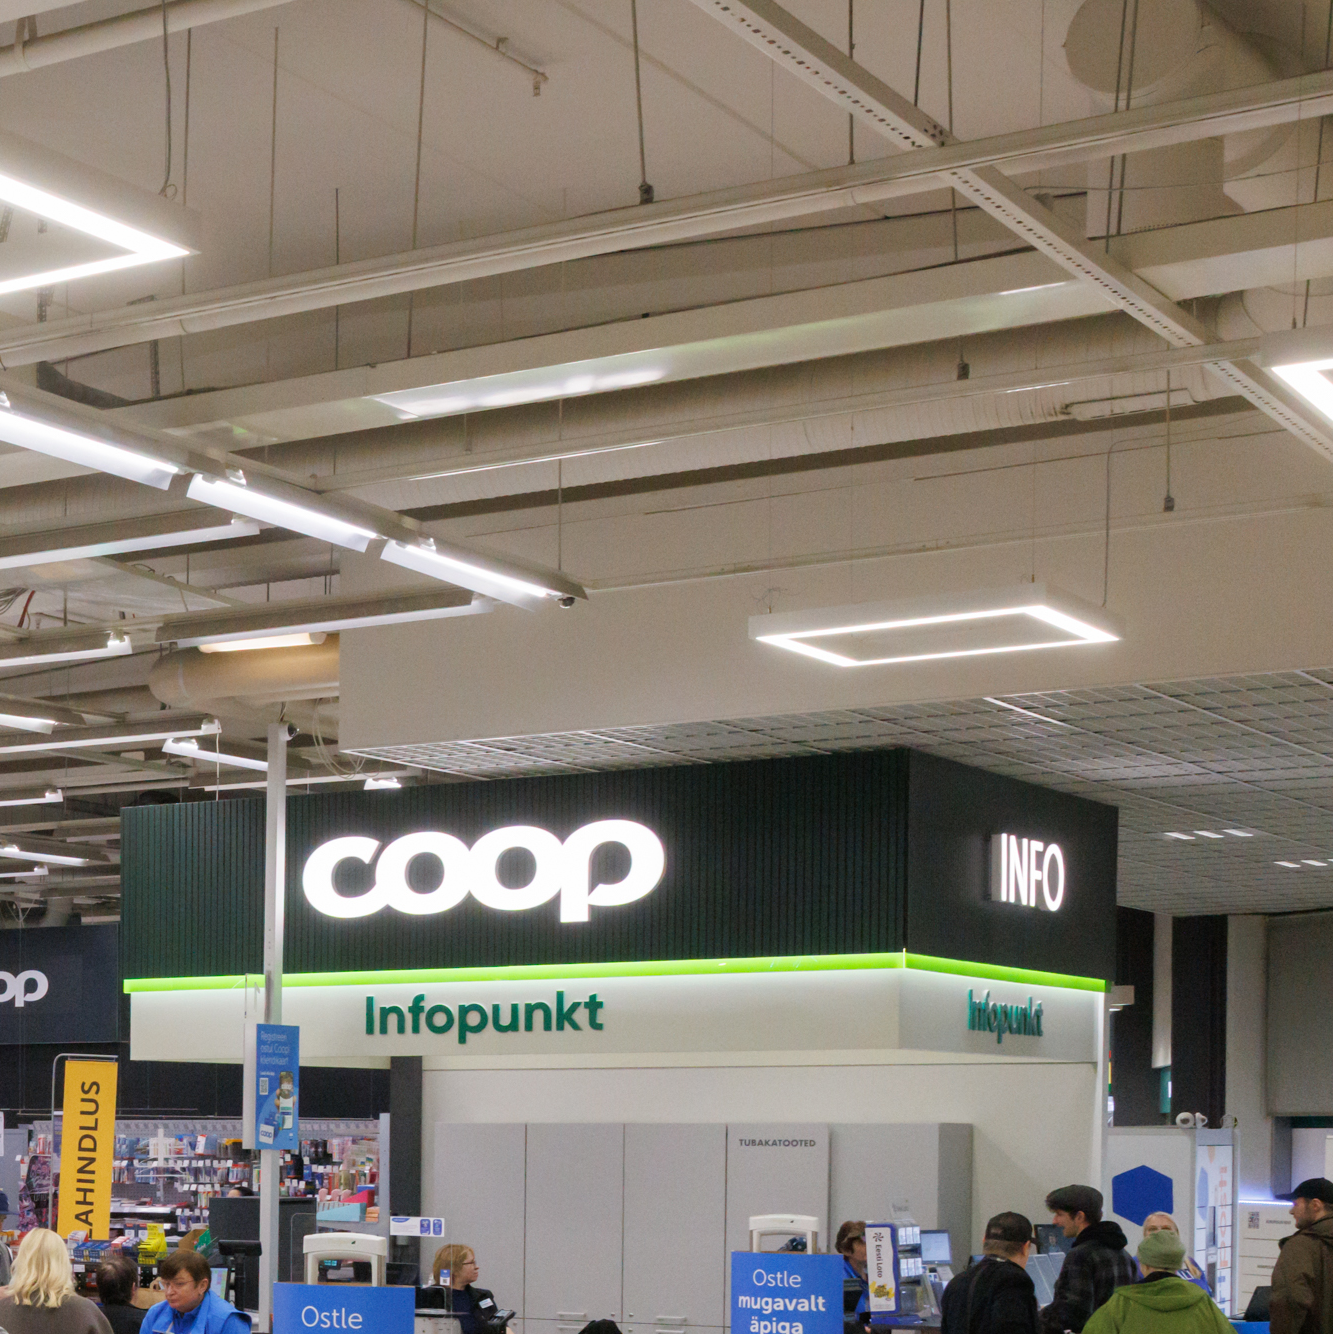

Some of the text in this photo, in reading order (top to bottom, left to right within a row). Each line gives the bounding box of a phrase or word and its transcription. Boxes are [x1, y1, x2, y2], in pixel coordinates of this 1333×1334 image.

[302, 819, 666, 923] coop
[999, 832, 1065, 912] INFO
[365, 990, 604, 1044] Infopunkt
[967, 988, 1044, 1044] Infopunkt
[739, 1138, 816, 1148] TUBAKATOOTED
[752, 1268, 802, 1288] Ostle
[875, 1244, 884, 1278] Eesti Loto
[301, 1305, 363, 1329] Ostle
[738, 1294, 826, 1315] mugavalt
